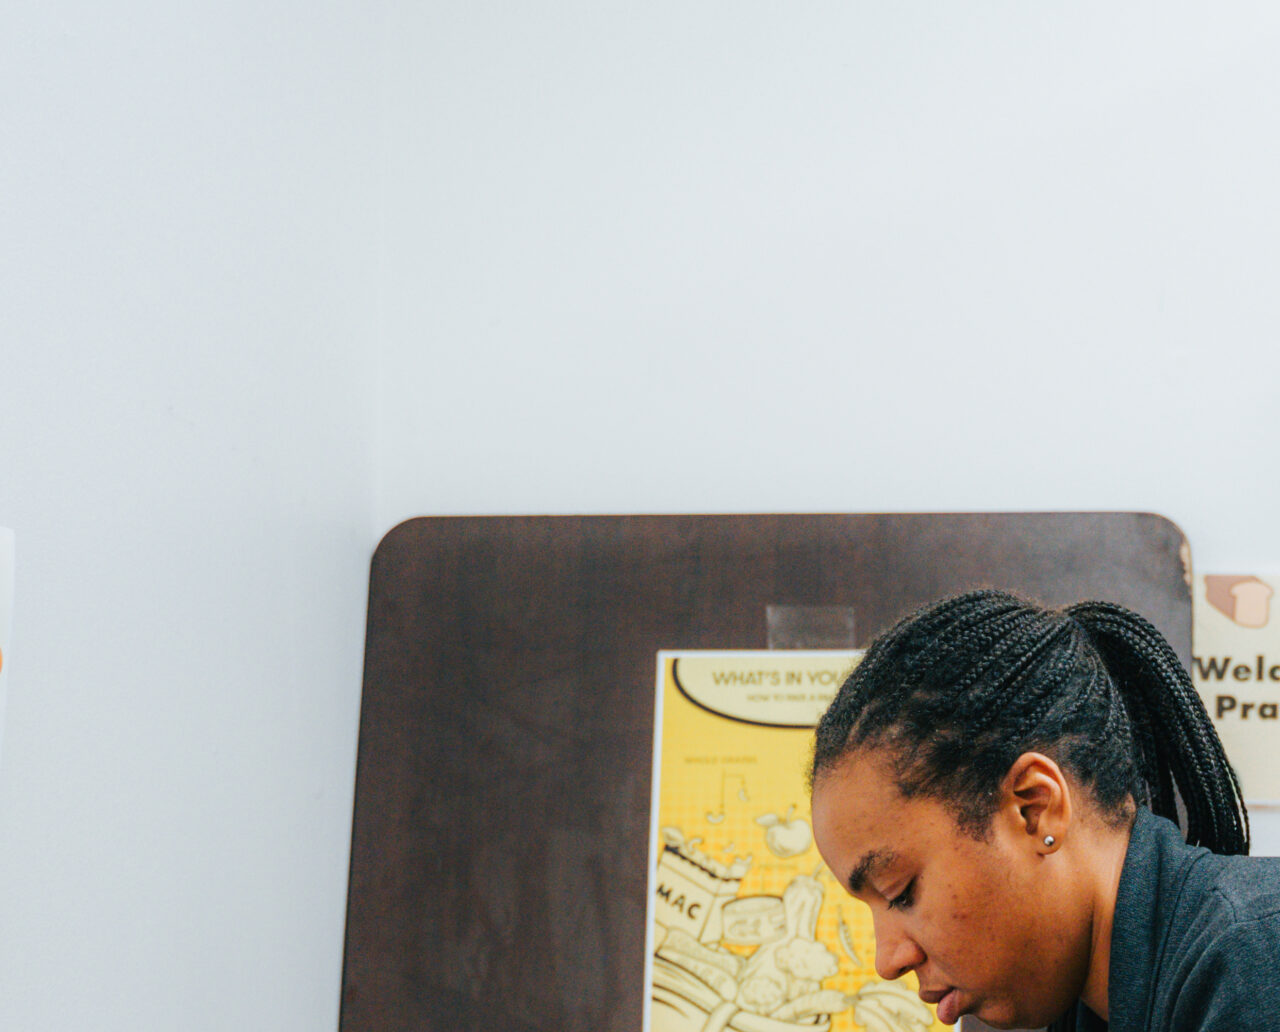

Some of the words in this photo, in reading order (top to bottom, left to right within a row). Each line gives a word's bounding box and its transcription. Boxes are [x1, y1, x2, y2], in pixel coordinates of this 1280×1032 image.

[712, 669, 780, 687] WHAT'S
[785, 671, 803, 687] IN
[656, 882, 702, 920] MAC
